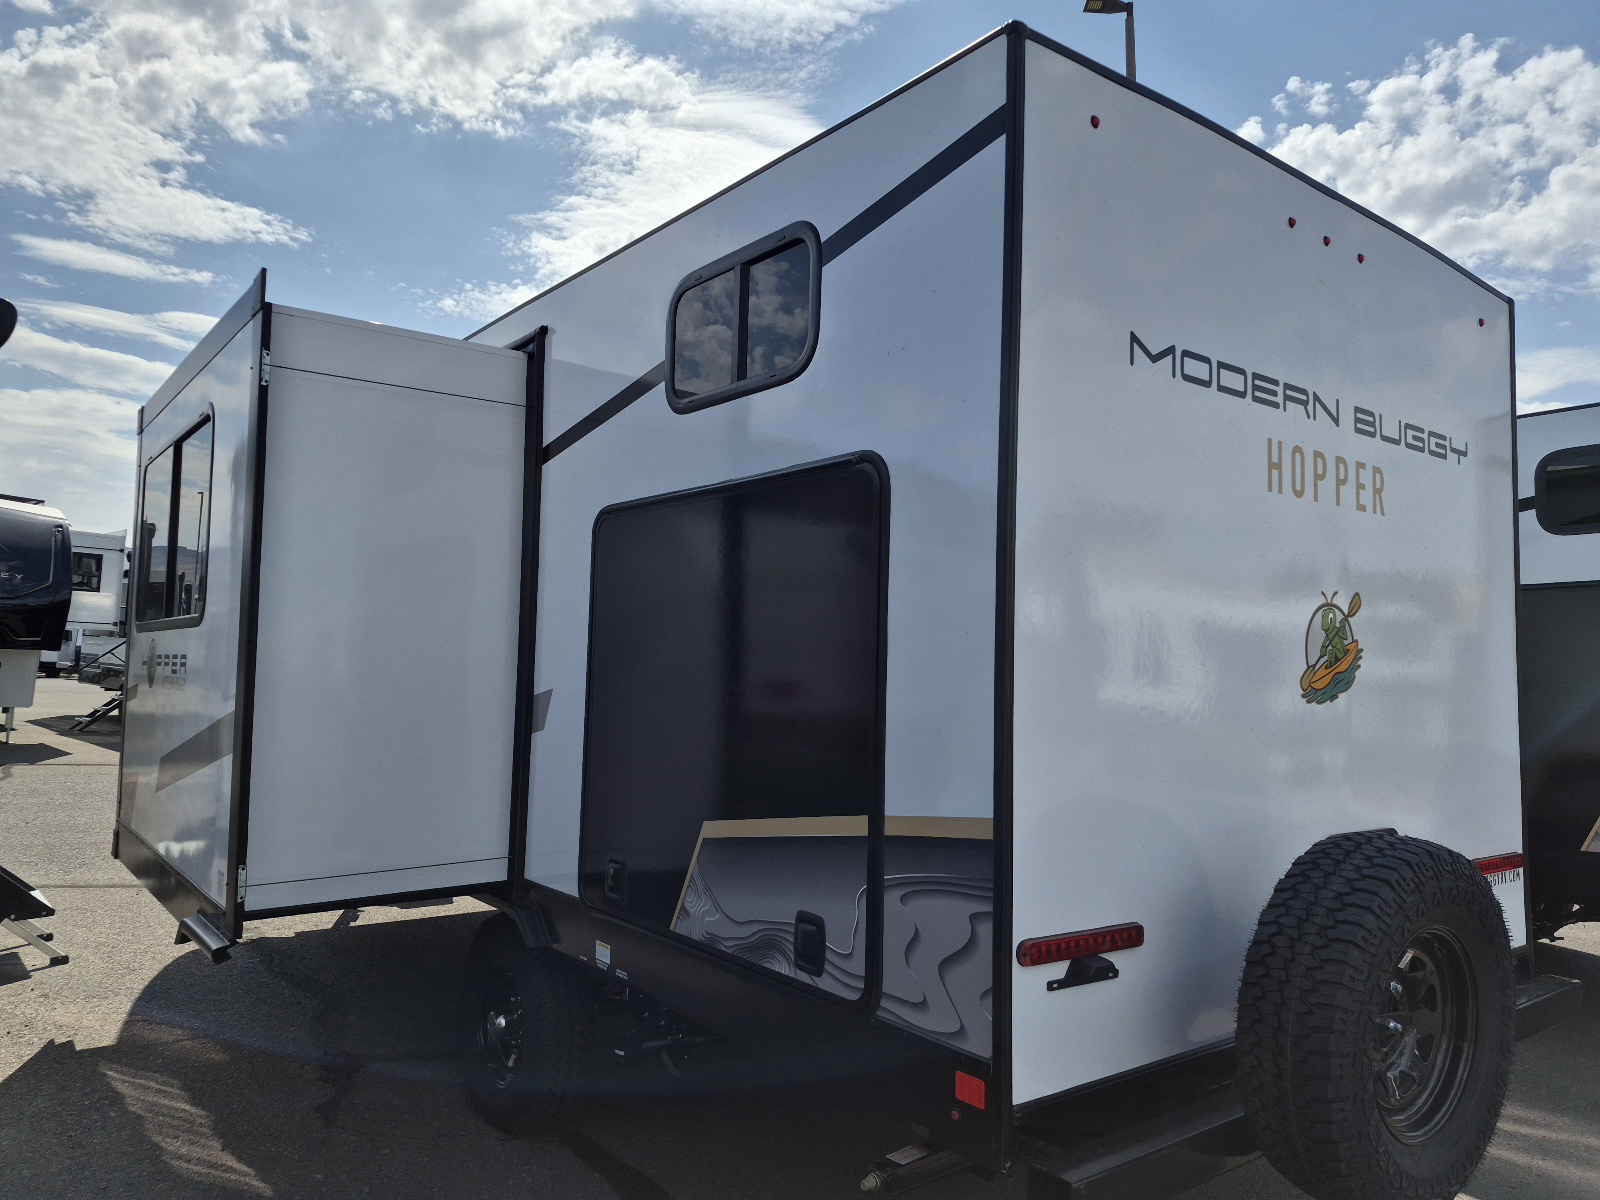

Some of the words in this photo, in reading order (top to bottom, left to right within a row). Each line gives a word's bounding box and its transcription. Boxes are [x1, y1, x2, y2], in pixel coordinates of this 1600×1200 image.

[1130, 330, 1339, 428] MODERN
[1354, 405, 1468, 465] BUGGY
[1267, 437, 1386, 517] HOPPER
